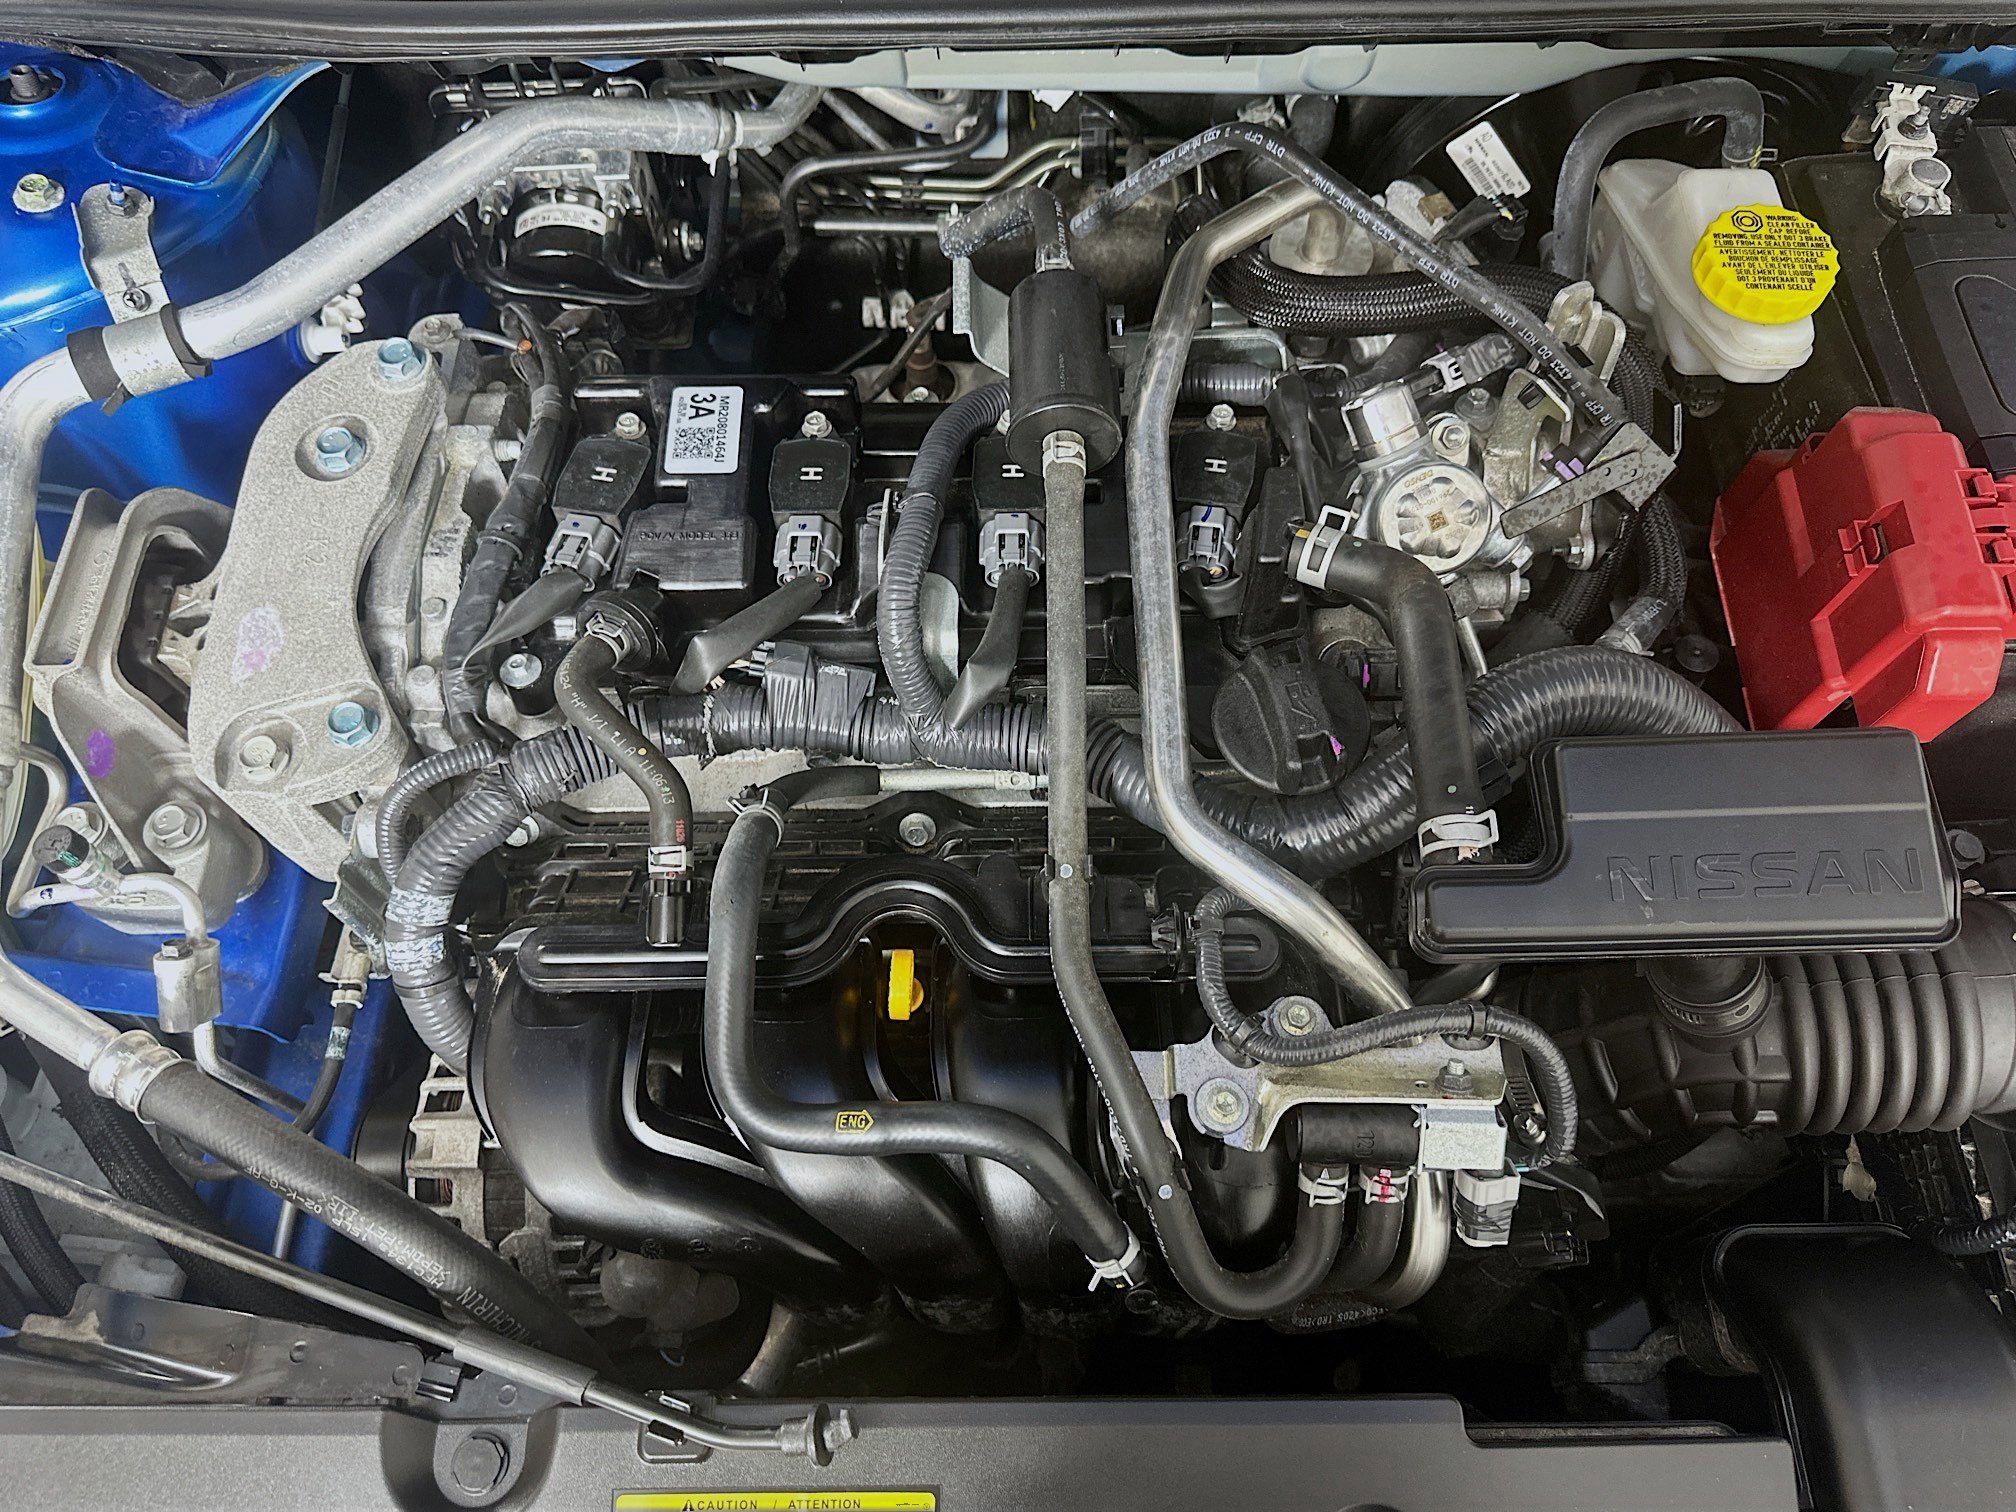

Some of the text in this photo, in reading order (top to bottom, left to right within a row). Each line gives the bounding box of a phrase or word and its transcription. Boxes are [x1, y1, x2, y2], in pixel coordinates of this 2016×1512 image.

[1311, 172, 1337, 196] KINK
[1337, 193, 1357, 213] NOT
[1371, 220, 1397, 242] 4323
[1490, 303, 1519, 328] KINK
[1518, 327, 1540, 347] NOT
[1550, 359, 1572, 380] 4323
[689, 394, 716, 420] 3A
[714, 395, 730, 463] MR20801464J
[1404, 469, 1434, 488] DENSO
[679, 531, 716, 540] MODEL
[1607, 848, 1925, 901] NISSAN
[839, 1115, 866, 1129] ENG
[697, 1500, 758, 1511] CAUTION
[788, 1499, 862, 1510] ATTENTION
